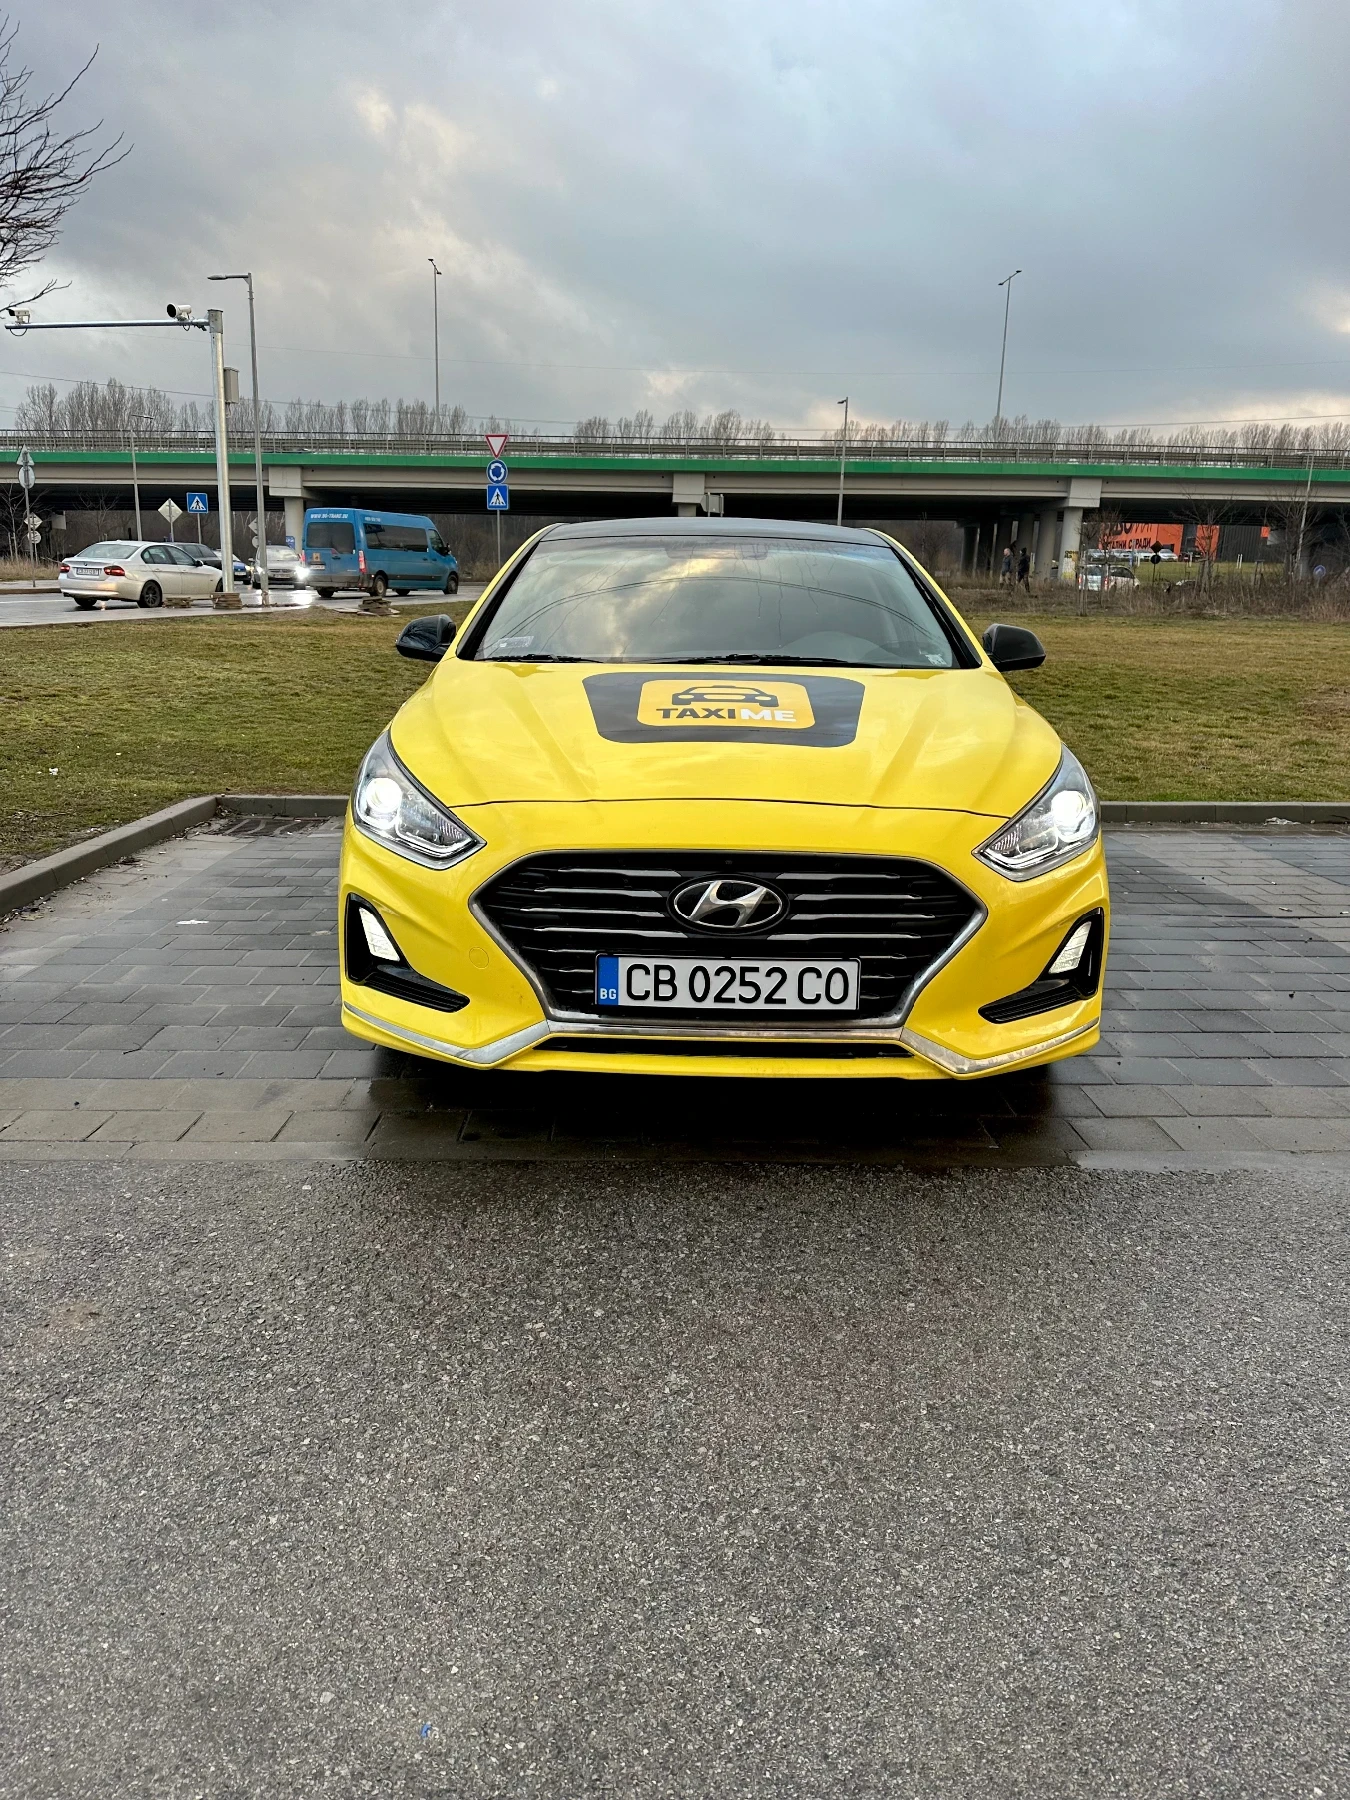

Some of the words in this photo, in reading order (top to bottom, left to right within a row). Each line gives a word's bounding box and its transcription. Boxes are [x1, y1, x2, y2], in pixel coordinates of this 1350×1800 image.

[1128, 537, 1152, 550] СРАДИ
[626, 963, 678, 1002] CB
[688, 965, 788, 1004] 0252
[797, 966, 849, 1005] CO
[600, 987, 617, 1000] BG
